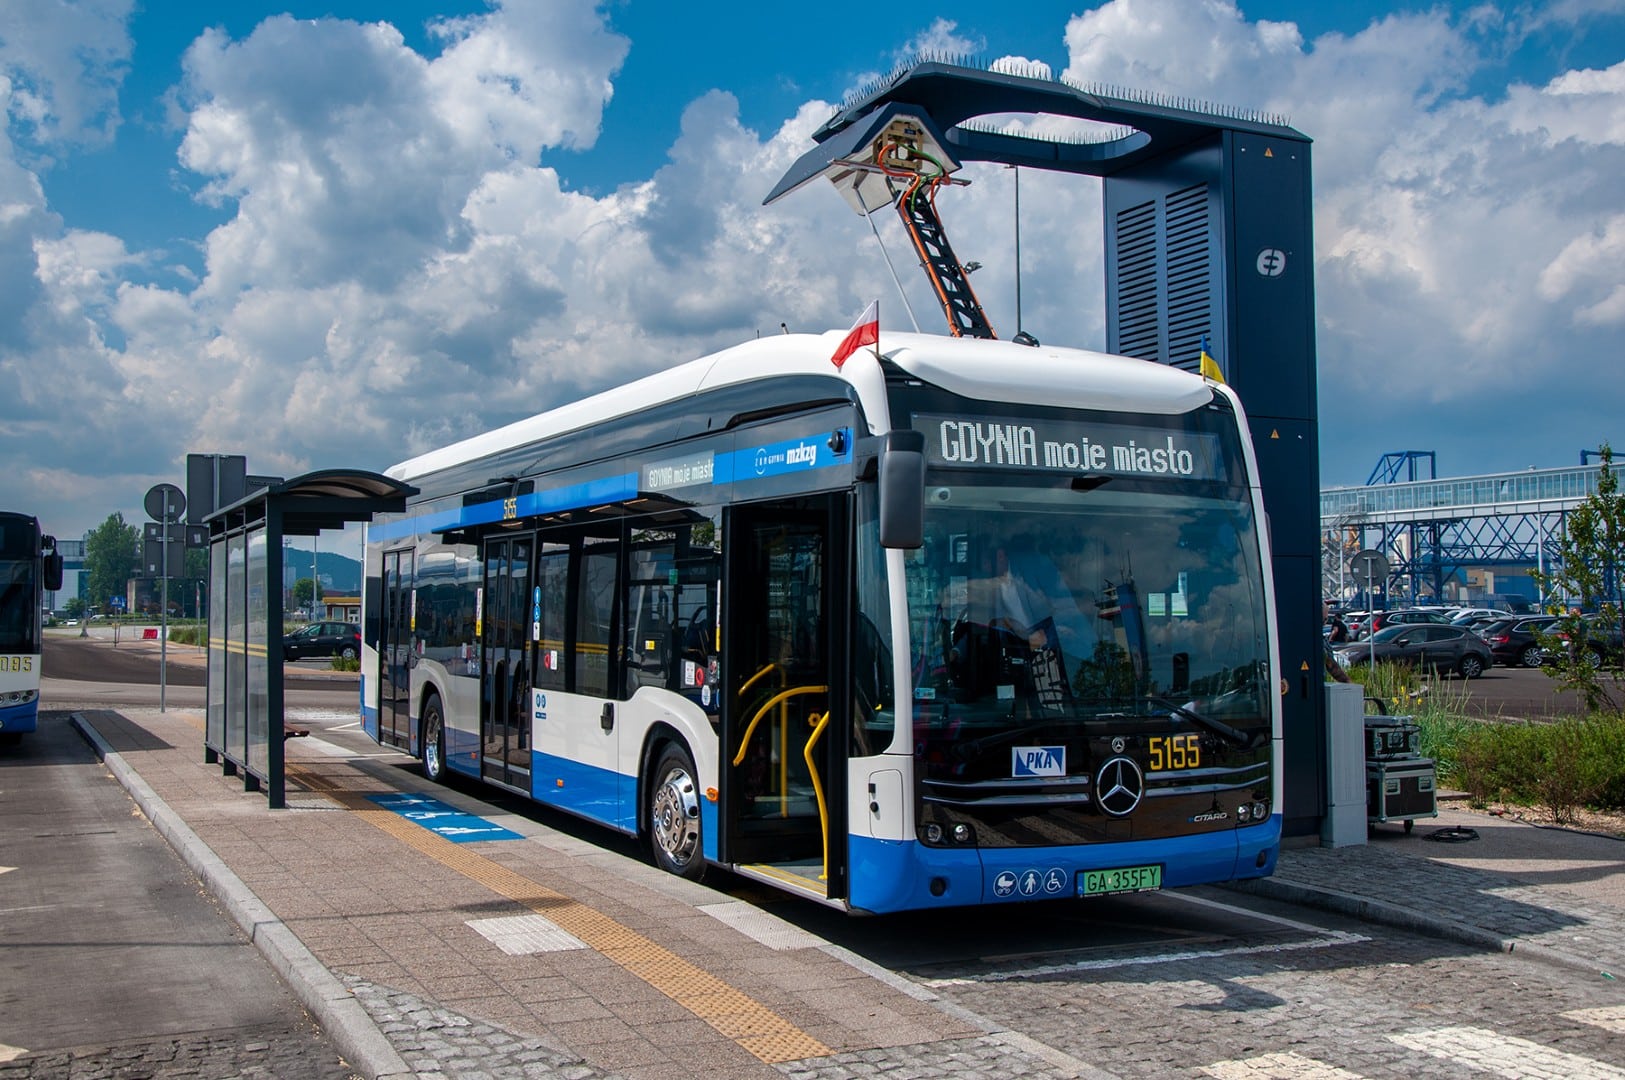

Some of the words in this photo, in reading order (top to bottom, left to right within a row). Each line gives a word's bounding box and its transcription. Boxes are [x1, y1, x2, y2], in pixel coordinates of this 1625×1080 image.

[786, 441, 817, 466] mzkzg
[939, 420, 1038, 466] GDYNIA
[1043, 437, 1107, 471] moje
[1112, 436, 1193, 475] miasto
[649, 466, 673, 488] GDYNIA
[673, 463, 690, 483] moje
[1026, 751, 1052, 769] PKA
[1149, 735, 1200, 770] 5155
[1087, 873, 1107, 891] GA
[1113, 867, 1157, 889] 355FY
